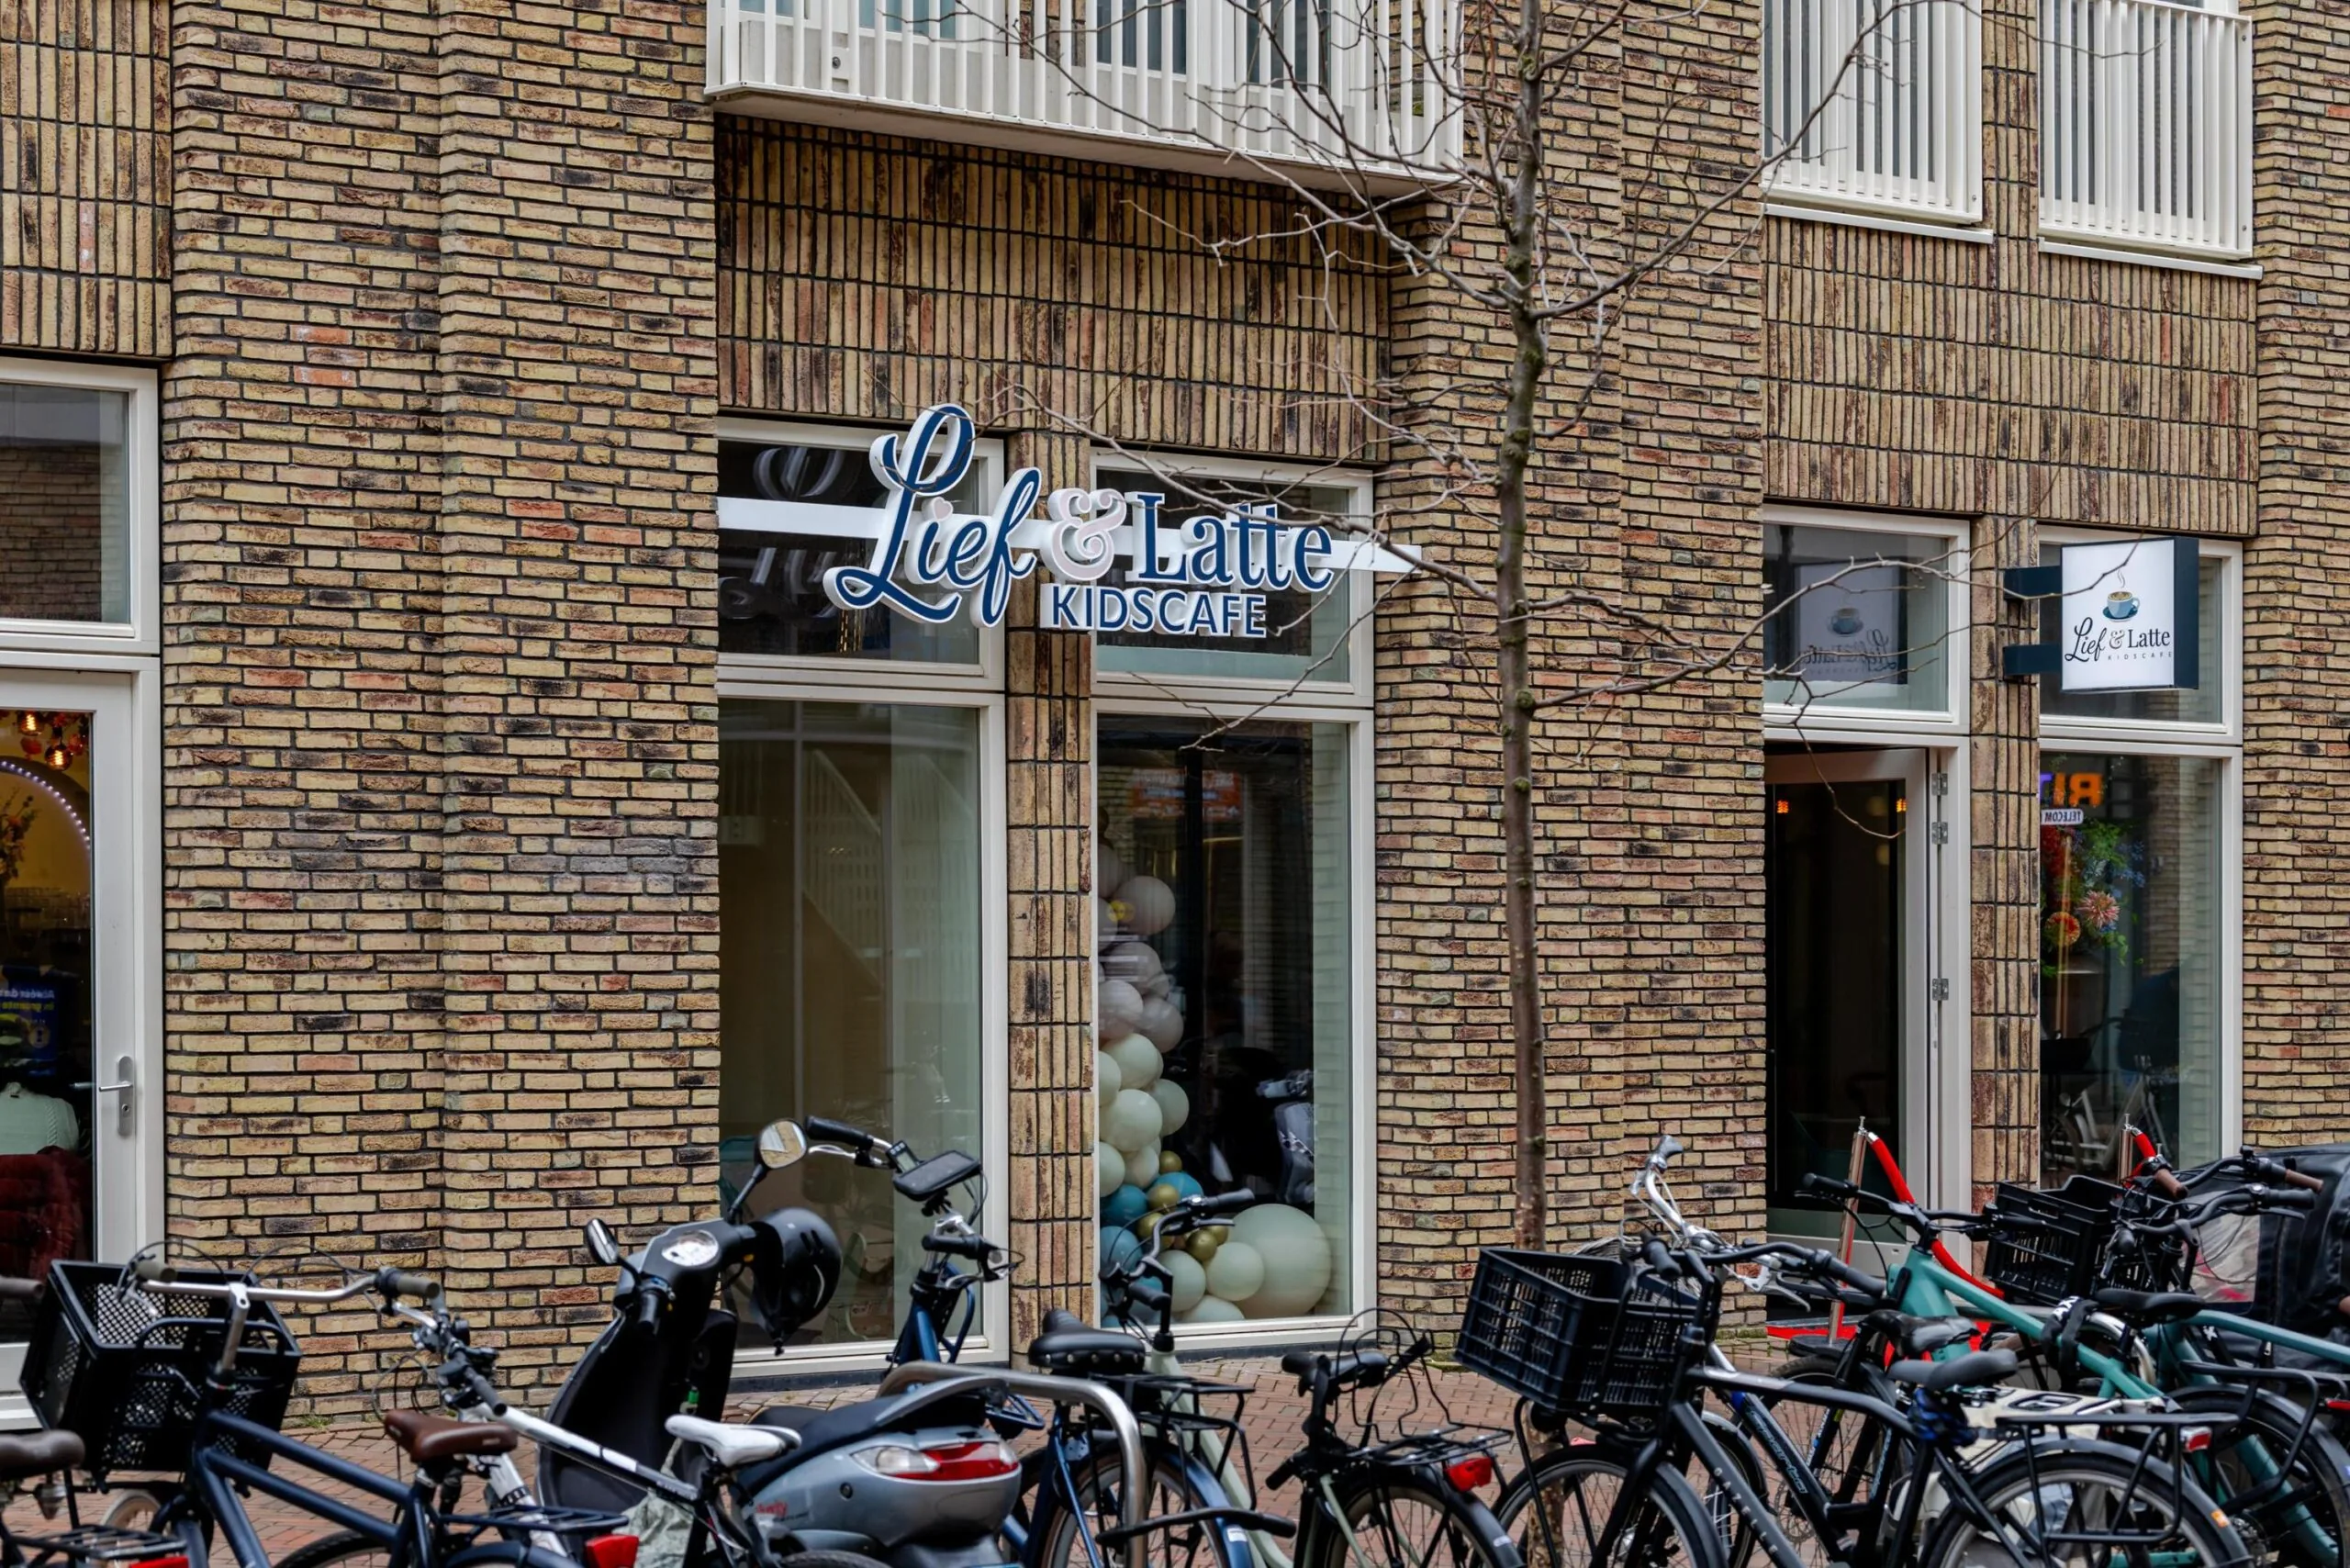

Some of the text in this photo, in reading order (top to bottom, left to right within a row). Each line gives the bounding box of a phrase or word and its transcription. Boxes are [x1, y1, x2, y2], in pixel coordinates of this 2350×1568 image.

[827, 403, 1334, 628] Lief & Latte
[1046, 584, 1268, 639] KIDSCAFE
[2065, 616, 2170, 662] Lief & Latte
[2108, 651, 2172, 660] KIDSCAFE
[1713, 1467, 1778, 1553] GAZELLE
